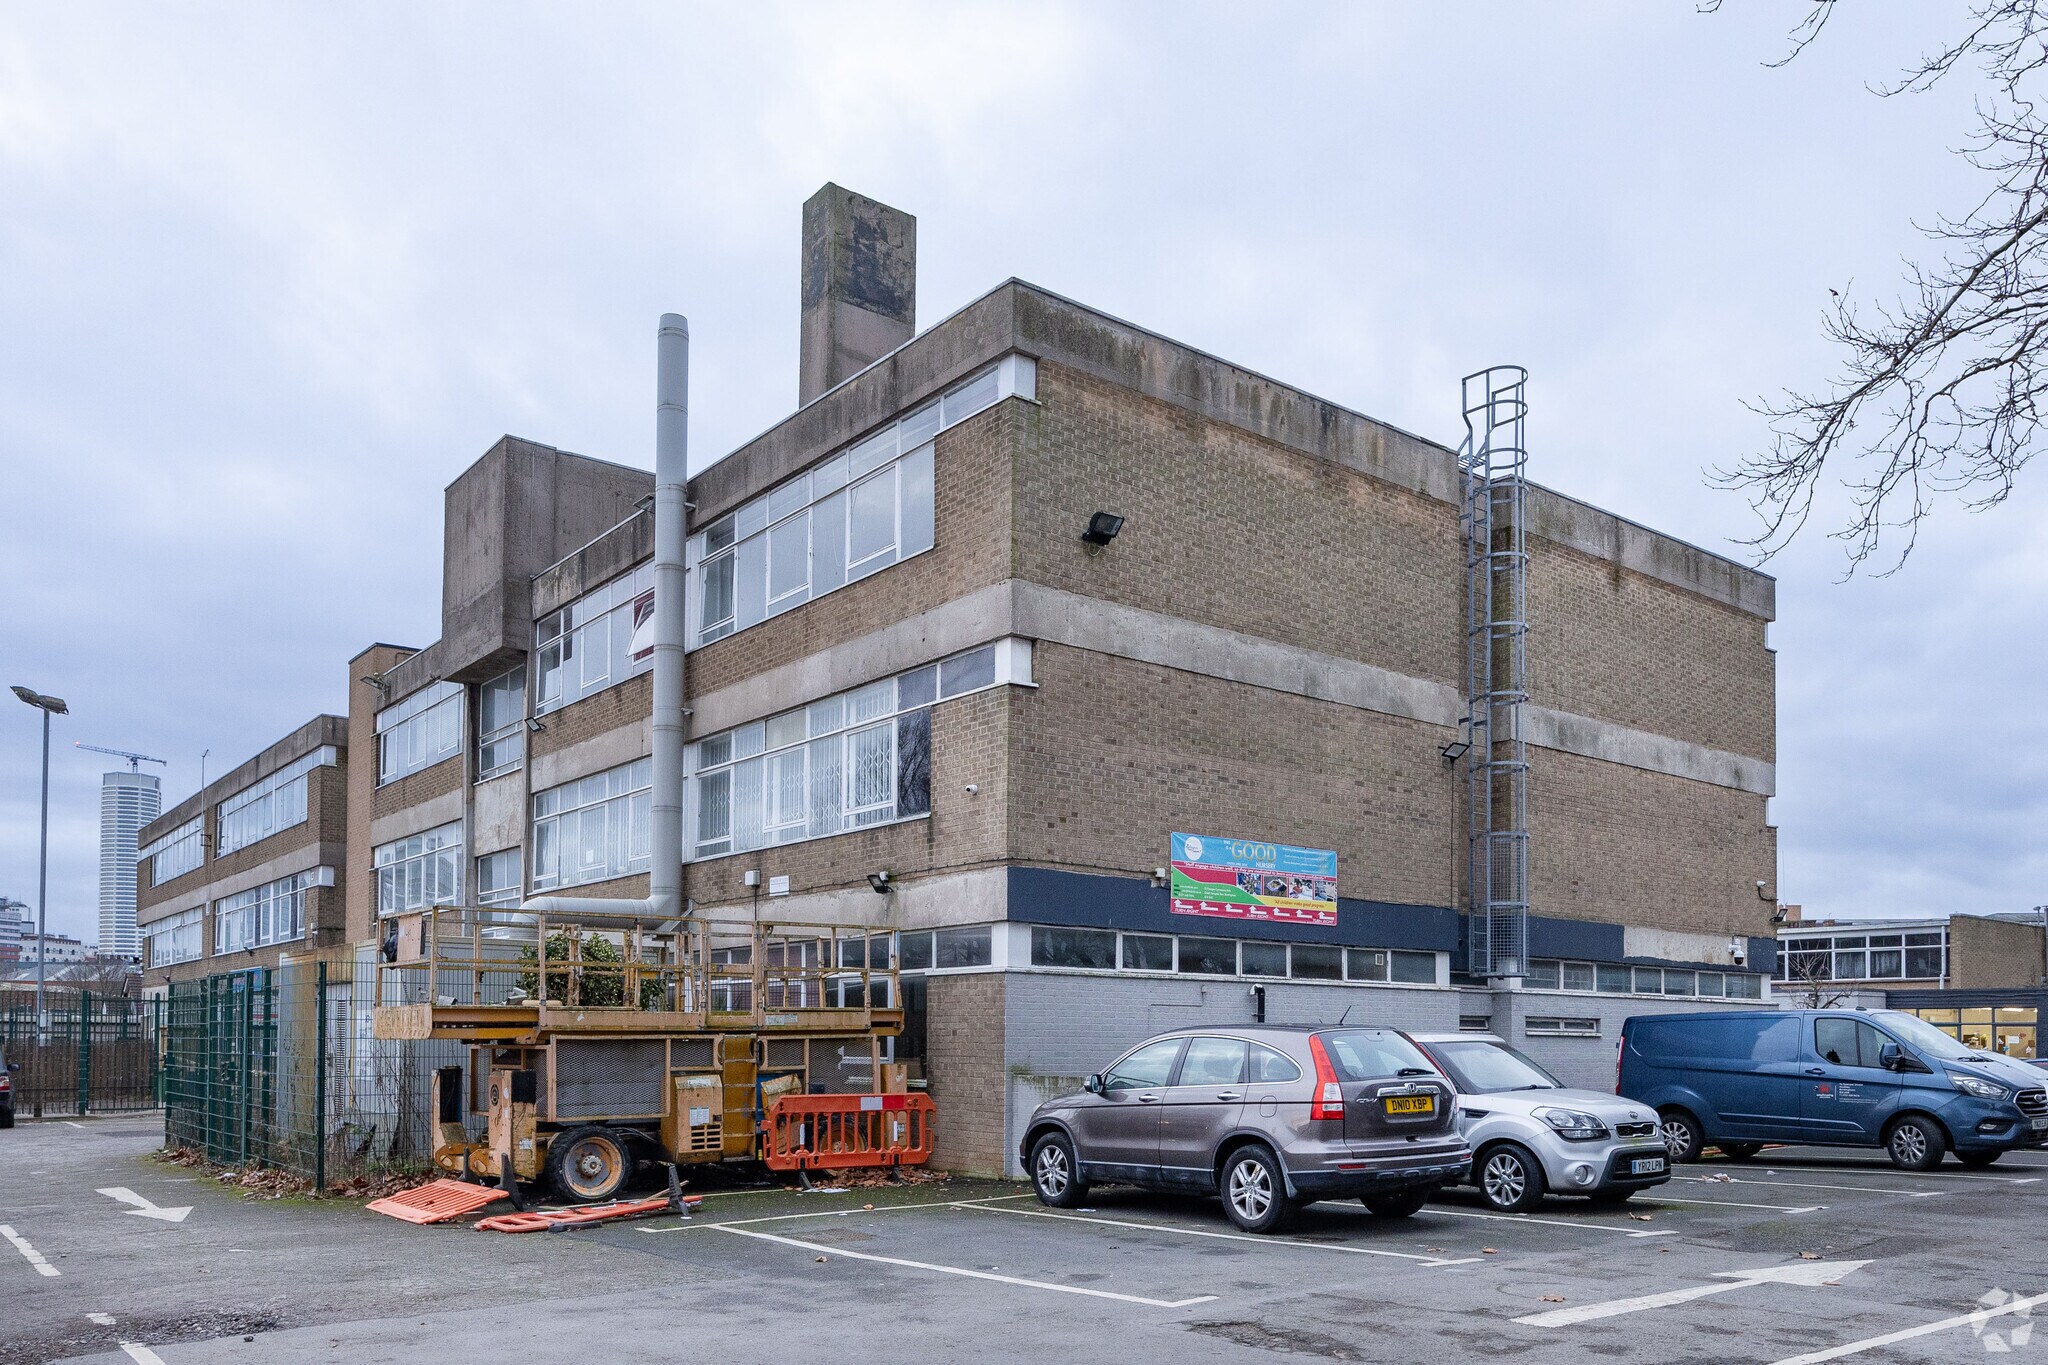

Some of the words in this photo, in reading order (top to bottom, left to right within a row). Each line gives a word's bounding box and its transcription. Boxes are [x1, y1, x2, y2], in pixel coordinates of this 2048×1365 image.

[1232, 841, 1276, 862] GOOD
[1392, 1100, 1410, 1111] DN10
[1413, 1099, 1427, 1110] XBP
